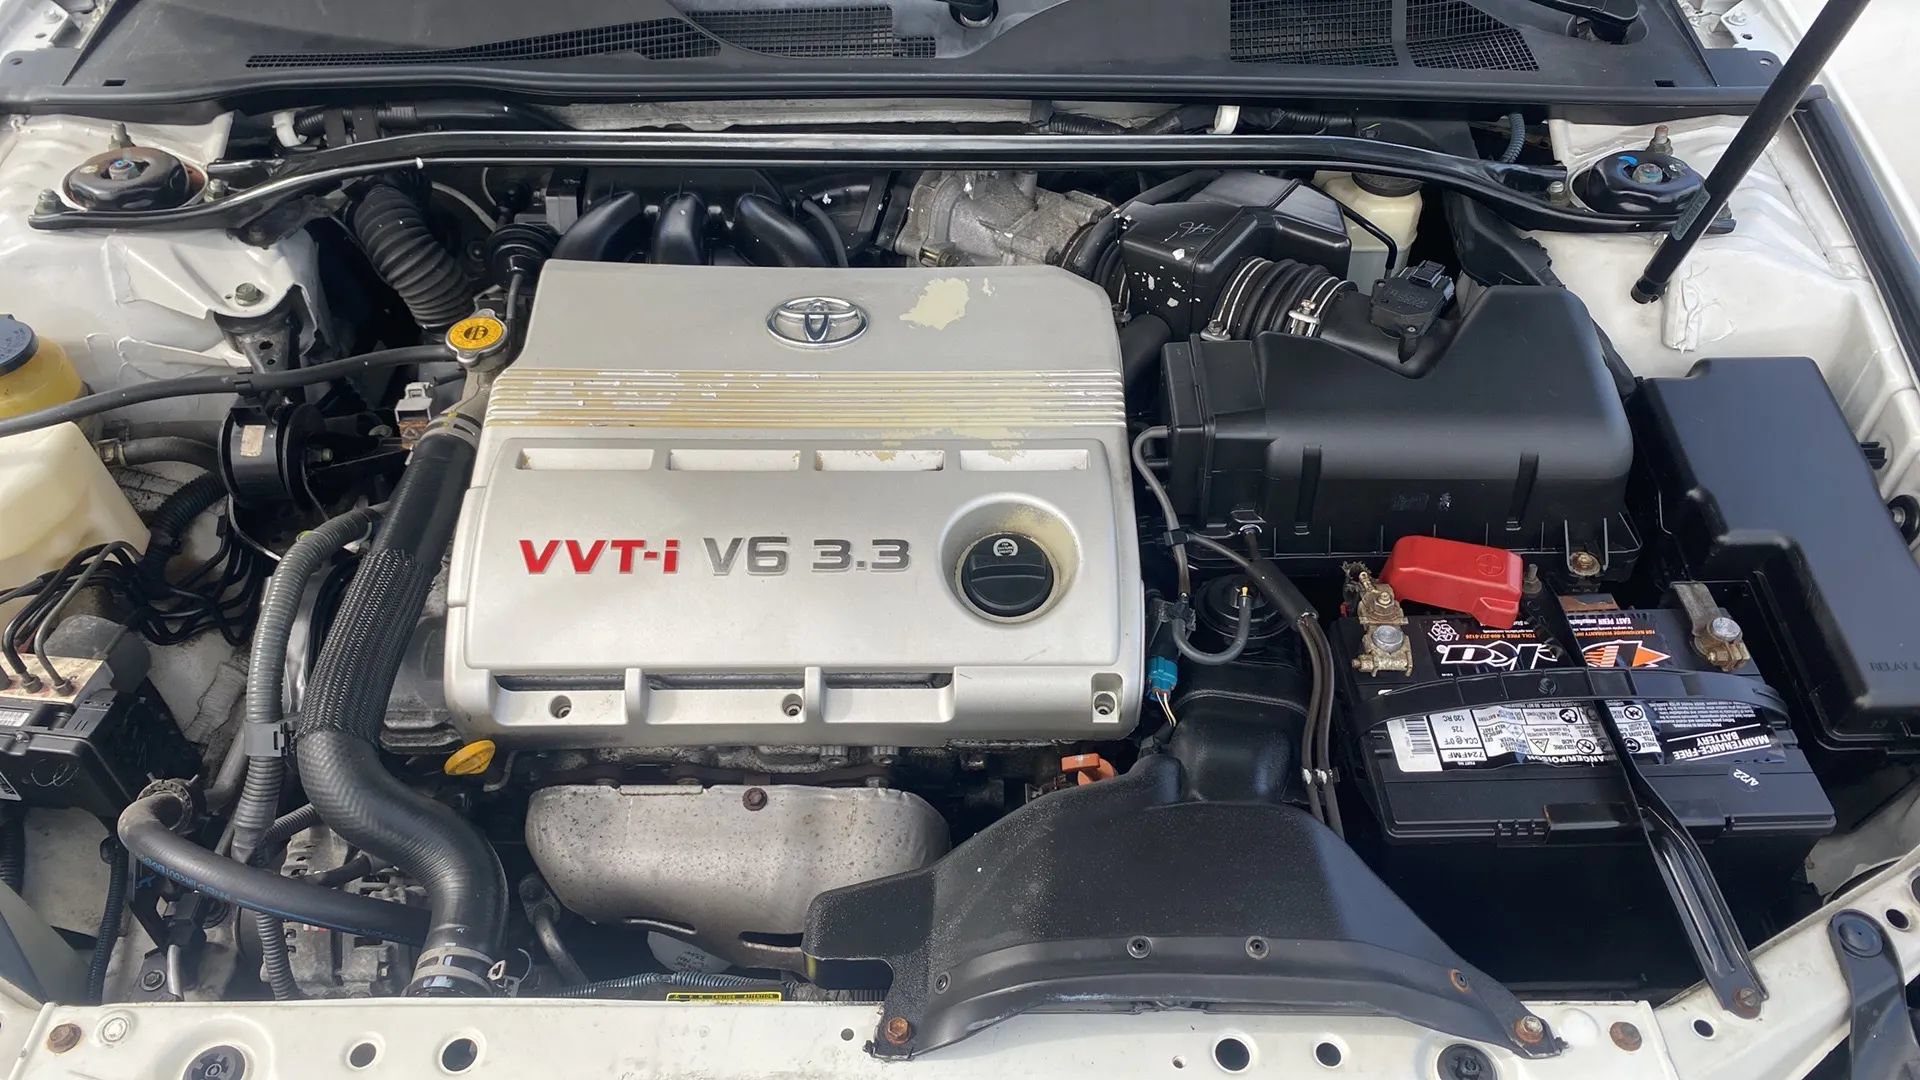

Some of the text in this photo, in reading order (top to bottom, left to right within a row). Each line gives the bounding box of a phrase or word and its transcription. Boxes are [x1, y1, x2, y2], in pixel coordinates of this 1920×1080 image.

[518, 536, 912, 576] VVT-i V6 3.3
[1451, 725, 1464, 733] 725
[1463, 737, 1478, 745] CCA
[1672, 734, 1770, 760] MAINTENANCE-FREE
[1696, 731, 1740, 747] BATTERY
[1447, 751, 1484, 759] 724FMF
[1733, 768, 1759, 786] 4/22
